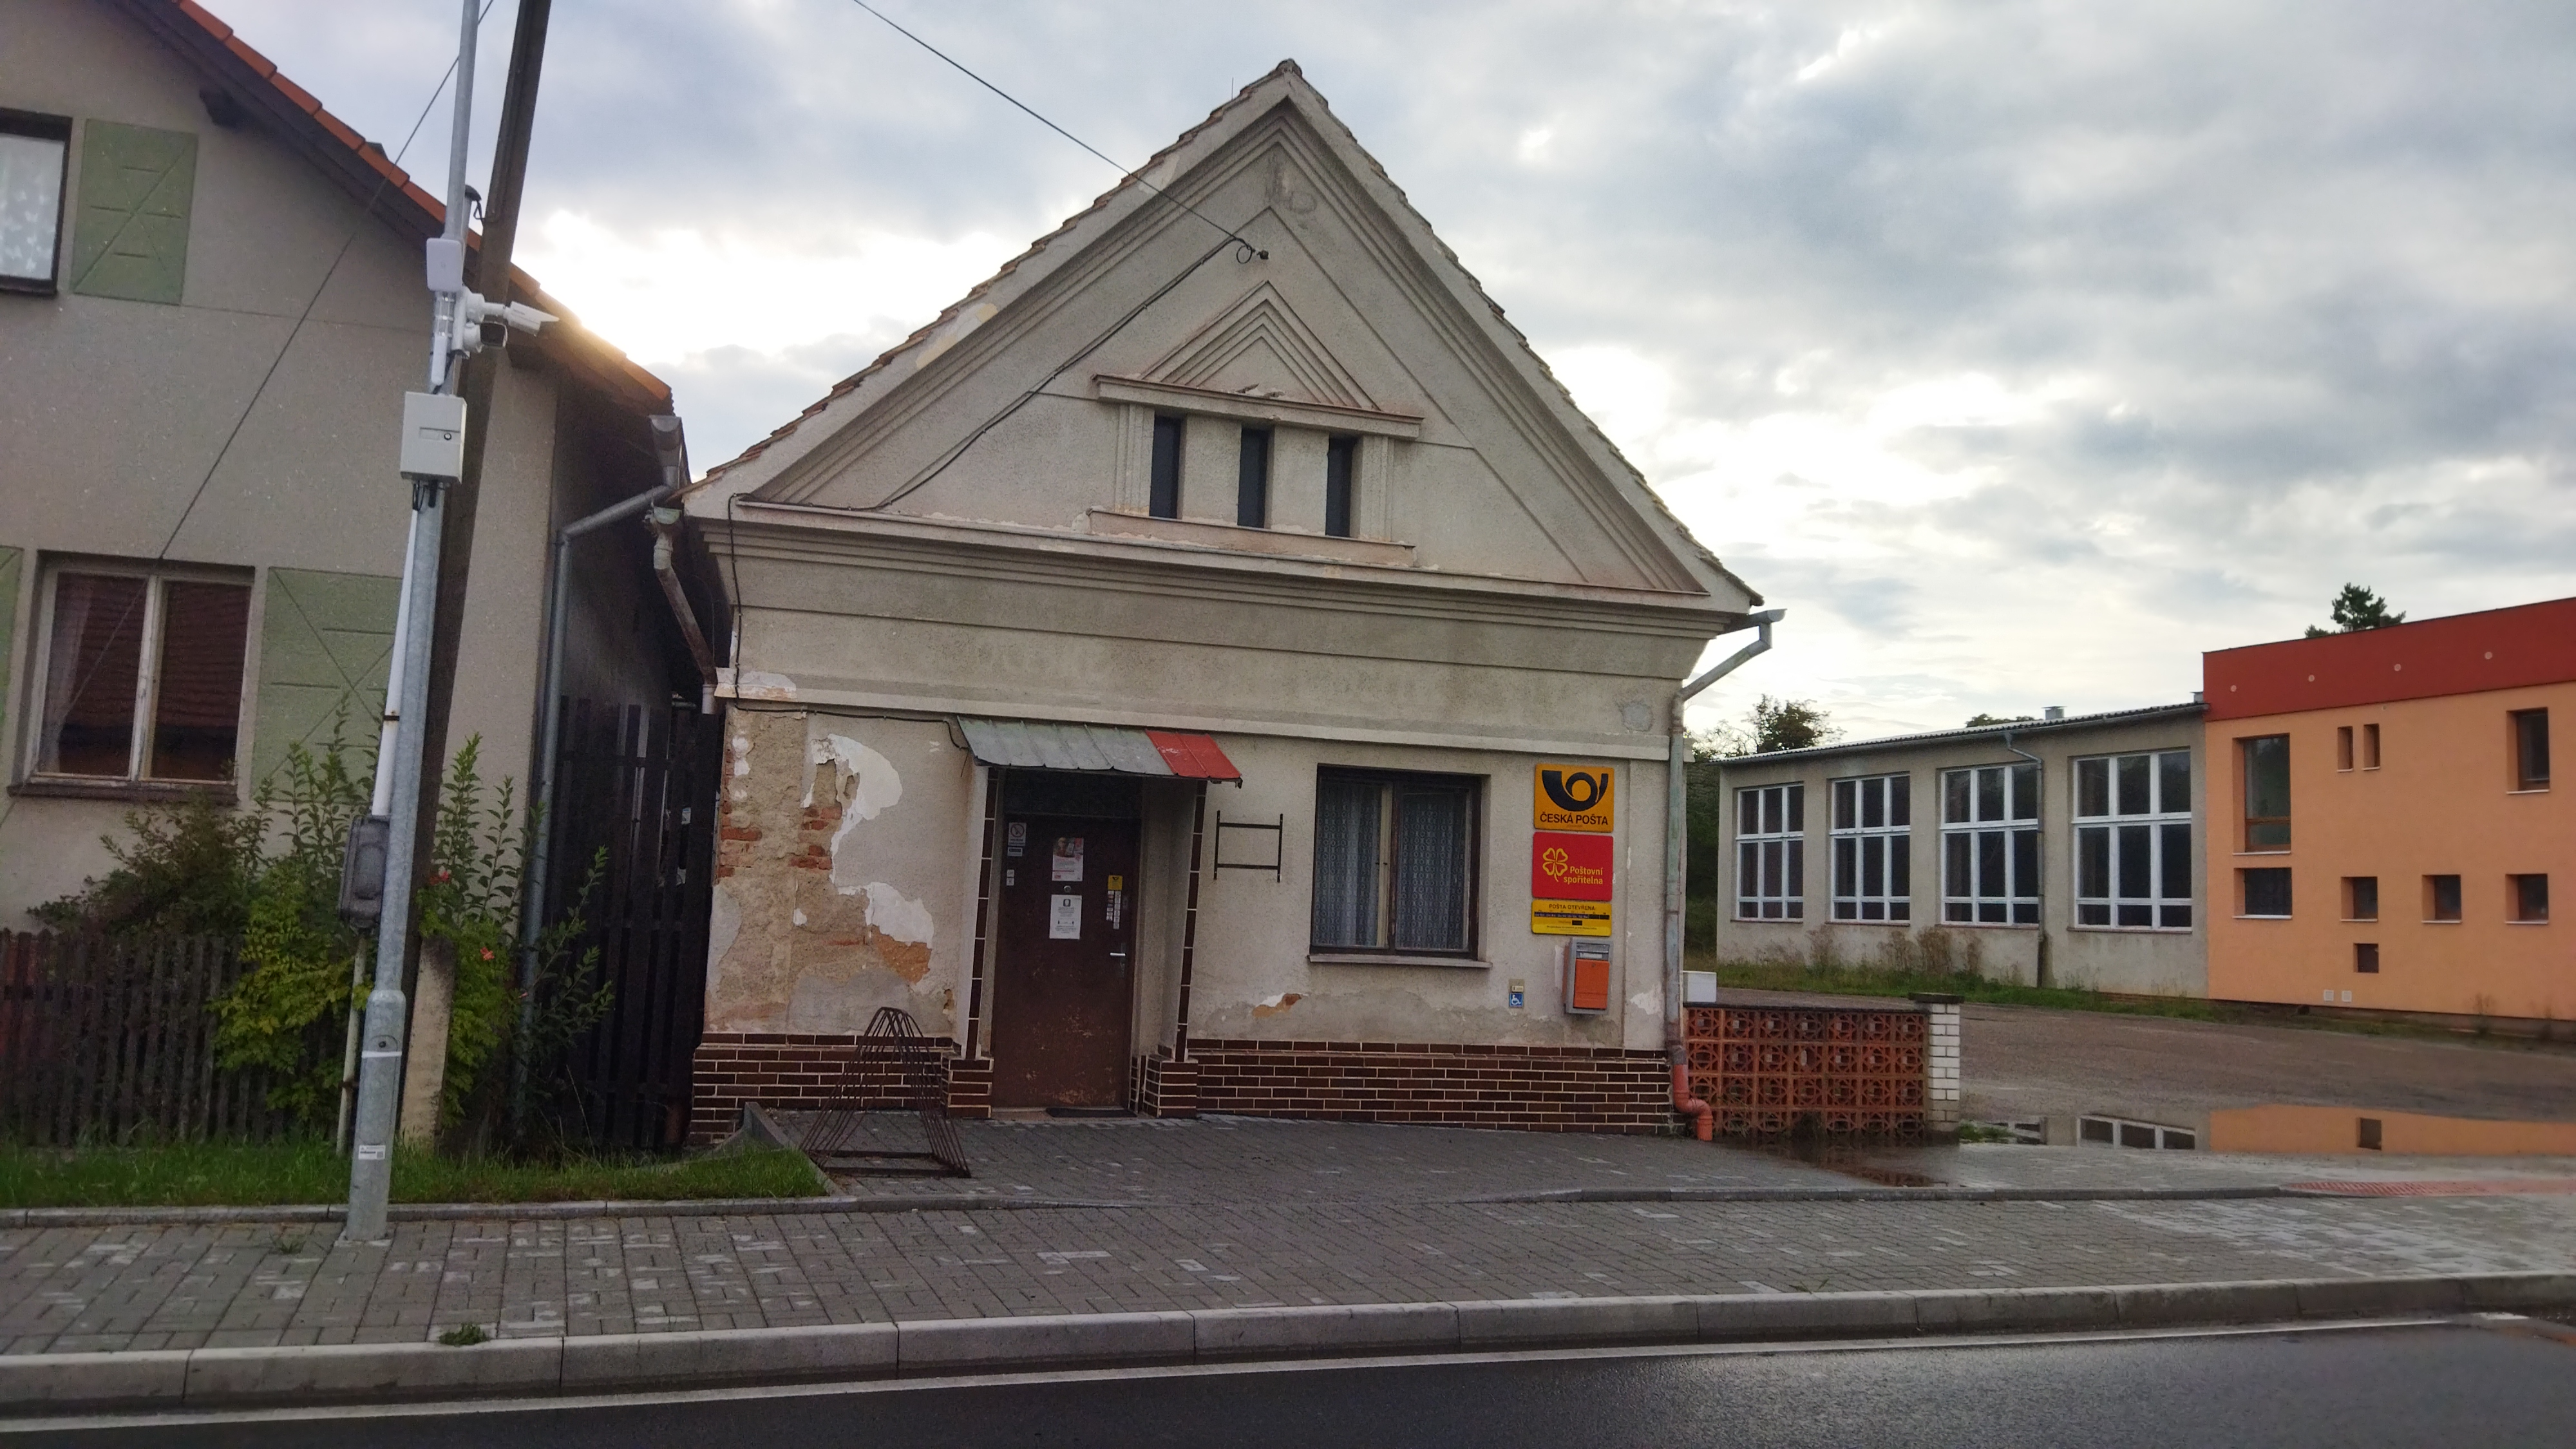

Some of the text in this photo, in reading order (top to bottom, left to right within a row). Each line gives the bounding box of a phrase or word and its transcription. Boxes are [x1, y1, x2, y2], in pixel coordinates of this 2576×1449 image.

[1540, 811, 1608, 825] ČESKÁ POŠTA
[1570, 866, 1603, 875] Poštovní
[1564, 876, 1603, 885] spořitelna
